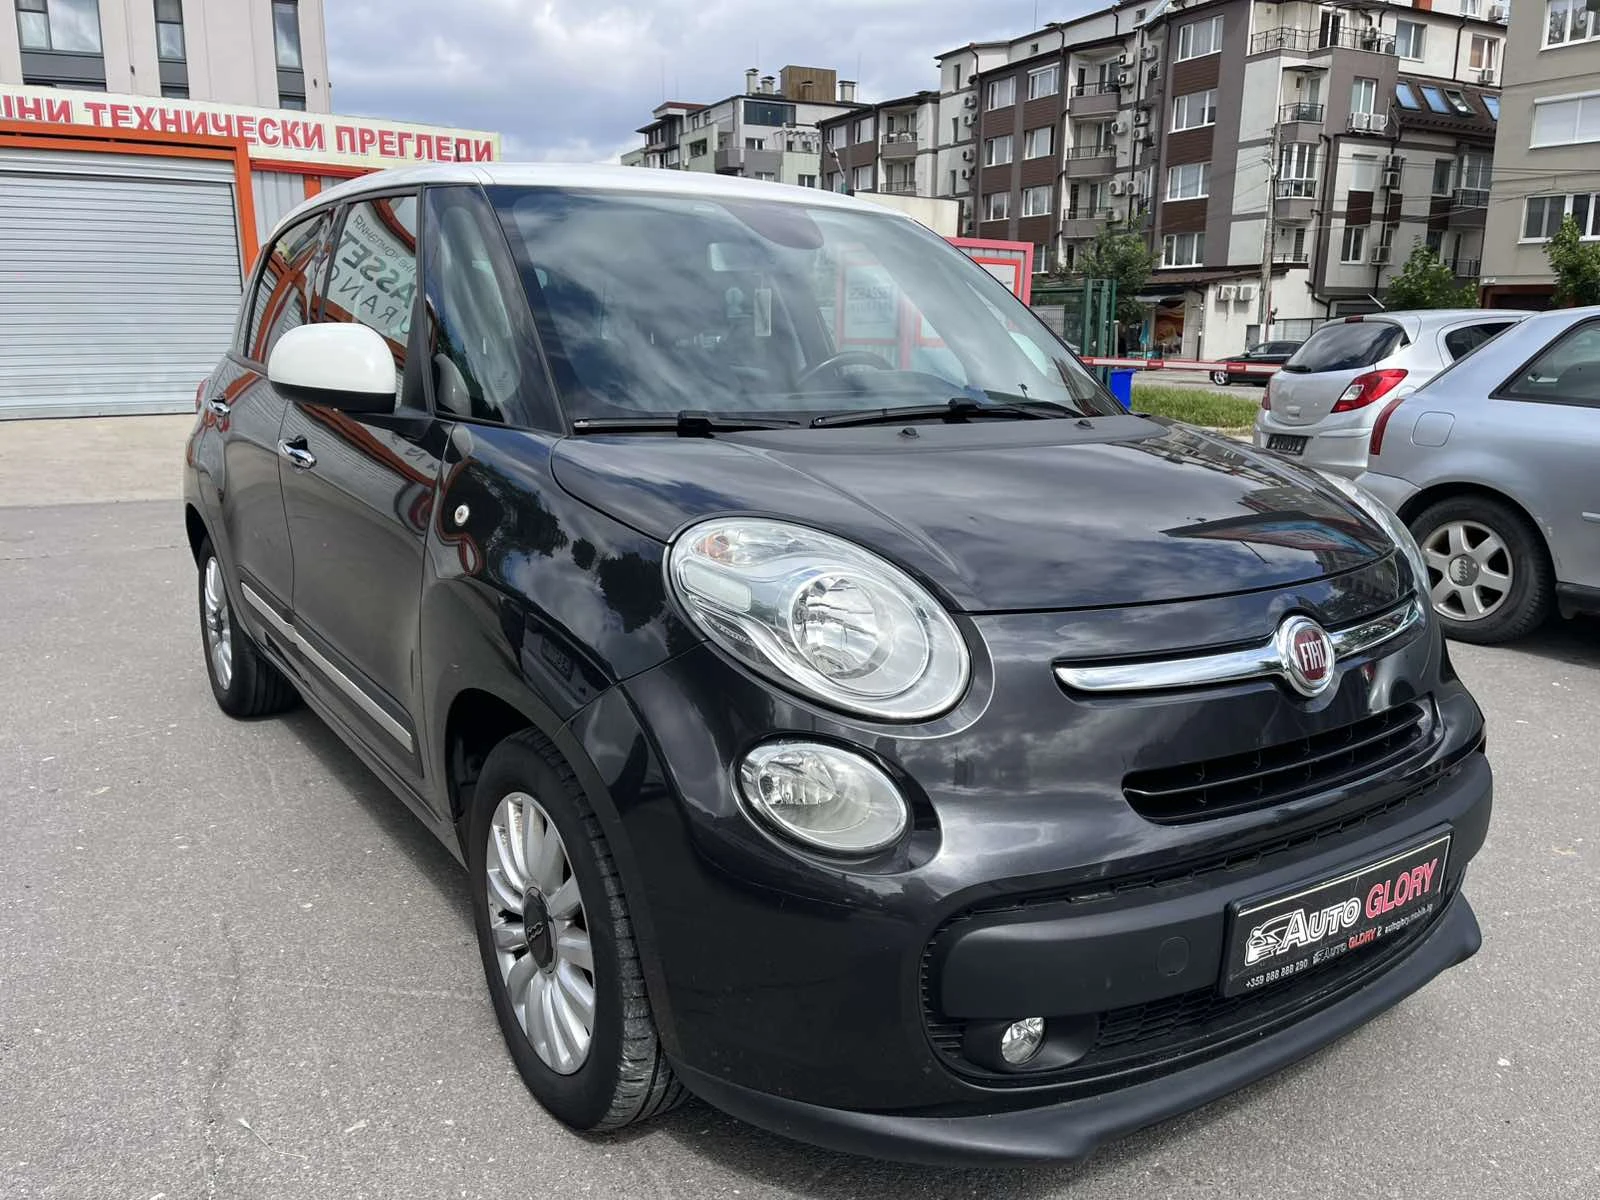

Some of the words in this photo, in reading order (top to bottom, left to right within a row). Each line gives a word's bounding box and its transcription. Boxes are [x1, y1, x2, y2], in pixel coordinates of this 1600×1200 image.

[84, 102, 325, 152] ТЕХНИЧЕСКИ
[335, 125, 494, 163] ПРЕГЛЕДИ
[1299, 640, 1326, 671] FIAT
[1365, 858, 1438, 919] GLORY
[1246, 975, 1264, 988] +359
[1265, 969, 1280, 982] 888
[1280, 964, 1294, 976] 888
[1295, 958, 1308, 972] 290
[1348, 928, 1377, 949] GLORY
